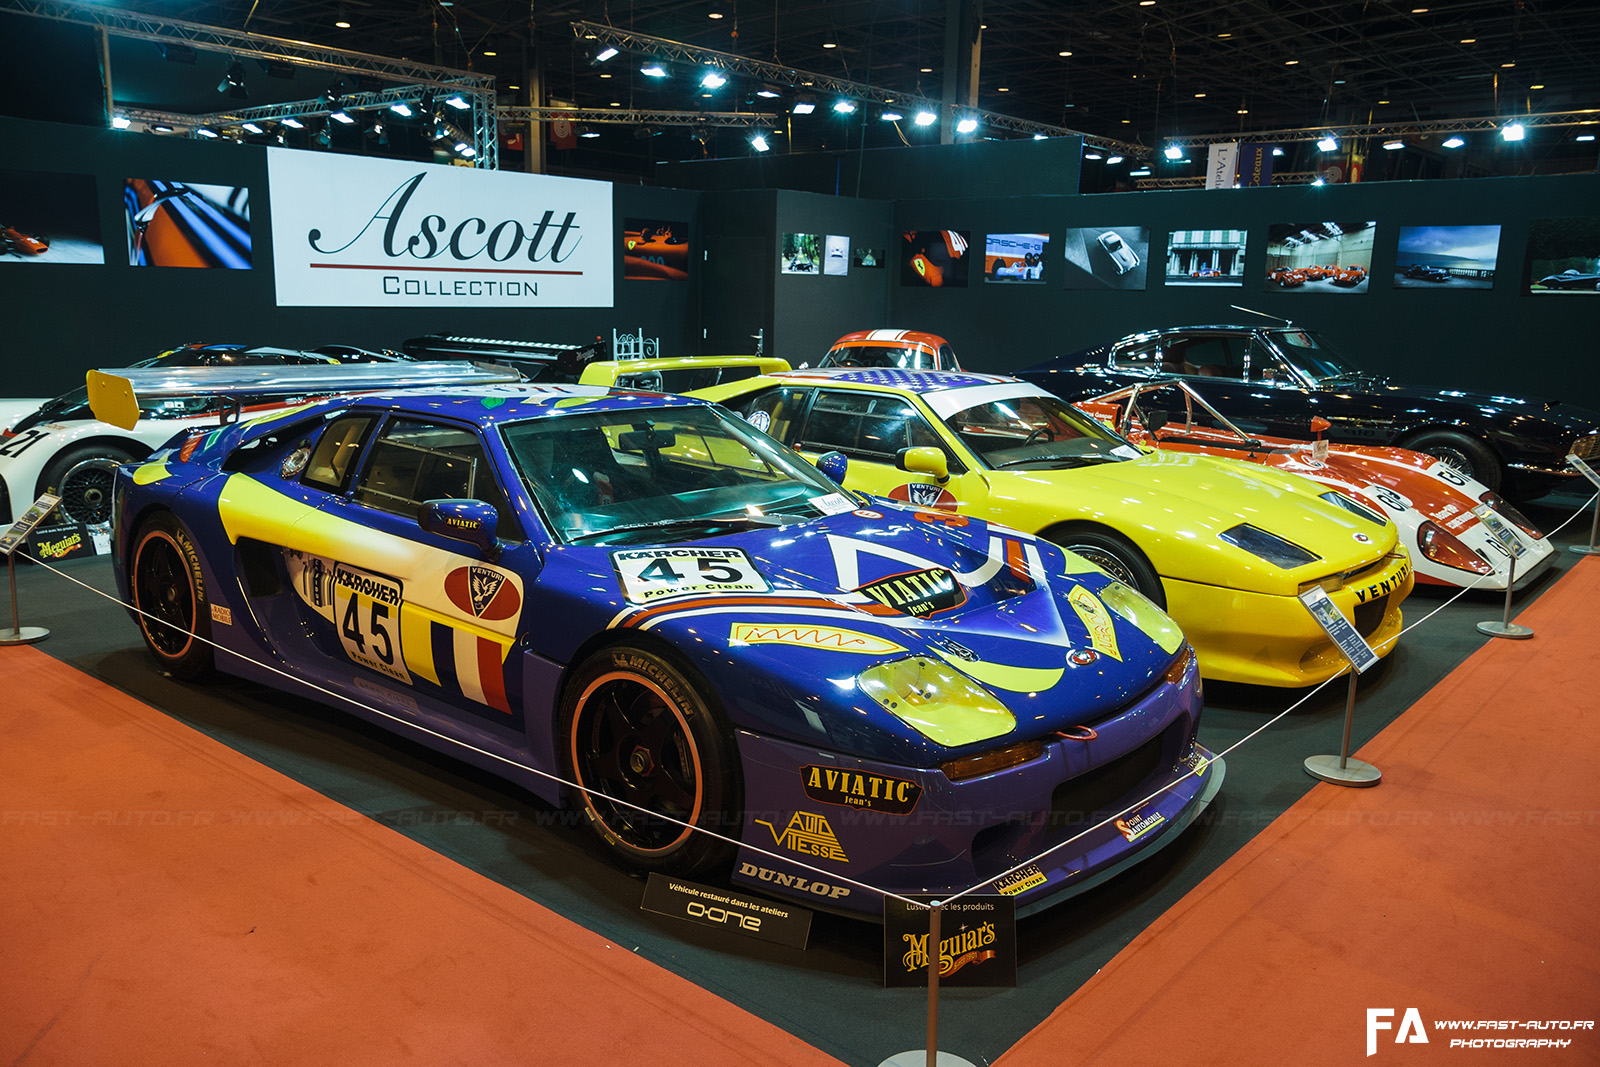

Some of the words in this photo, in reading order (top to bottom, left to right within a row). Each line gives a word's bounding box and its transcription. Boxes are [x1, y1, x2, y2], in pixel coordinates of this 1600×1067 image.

[308, 172, 583, 263] Ascott
[383, 276, 538, 297] COLLECTION
[0, 430, 51, 458] 21
[911, 483, 942, 492] VENTURI
[447, 518, 479, 530] AVIATIC
[183, 541, 204, 602] MICHELIN
[471, 567, 503, 582] VENTURI
[1355, 563, 1409, 603] VENTURI
[644, 586, 698, 598] Power
[907, 601, 935, 616] Jean's
[343, 592, 394, 665] 45
[629, 655, 694, 716] MICHELIN
[808, 766, 911, 803] AVIATIC
[844, 795, 872, 807] Jean's
[788, 811, 836, 838] AUTO
[755, 818, 849, 863] VITESSE
[738, 862, 850, 899] DUNLOP
[1025, 876, 1044, 887] Clean
[669, 882, 700, 897] Véhicule
[700, 891, 730, 904] restauré
[731, 898, 749, 909] dans
[750, 902, 760, 912] les
[760, 905, 789, 918] ateliers
[950, 902, 961, 911] les
[962, 902, 995, 912] produits
[902, 921, 997, 975] Mguiar's
